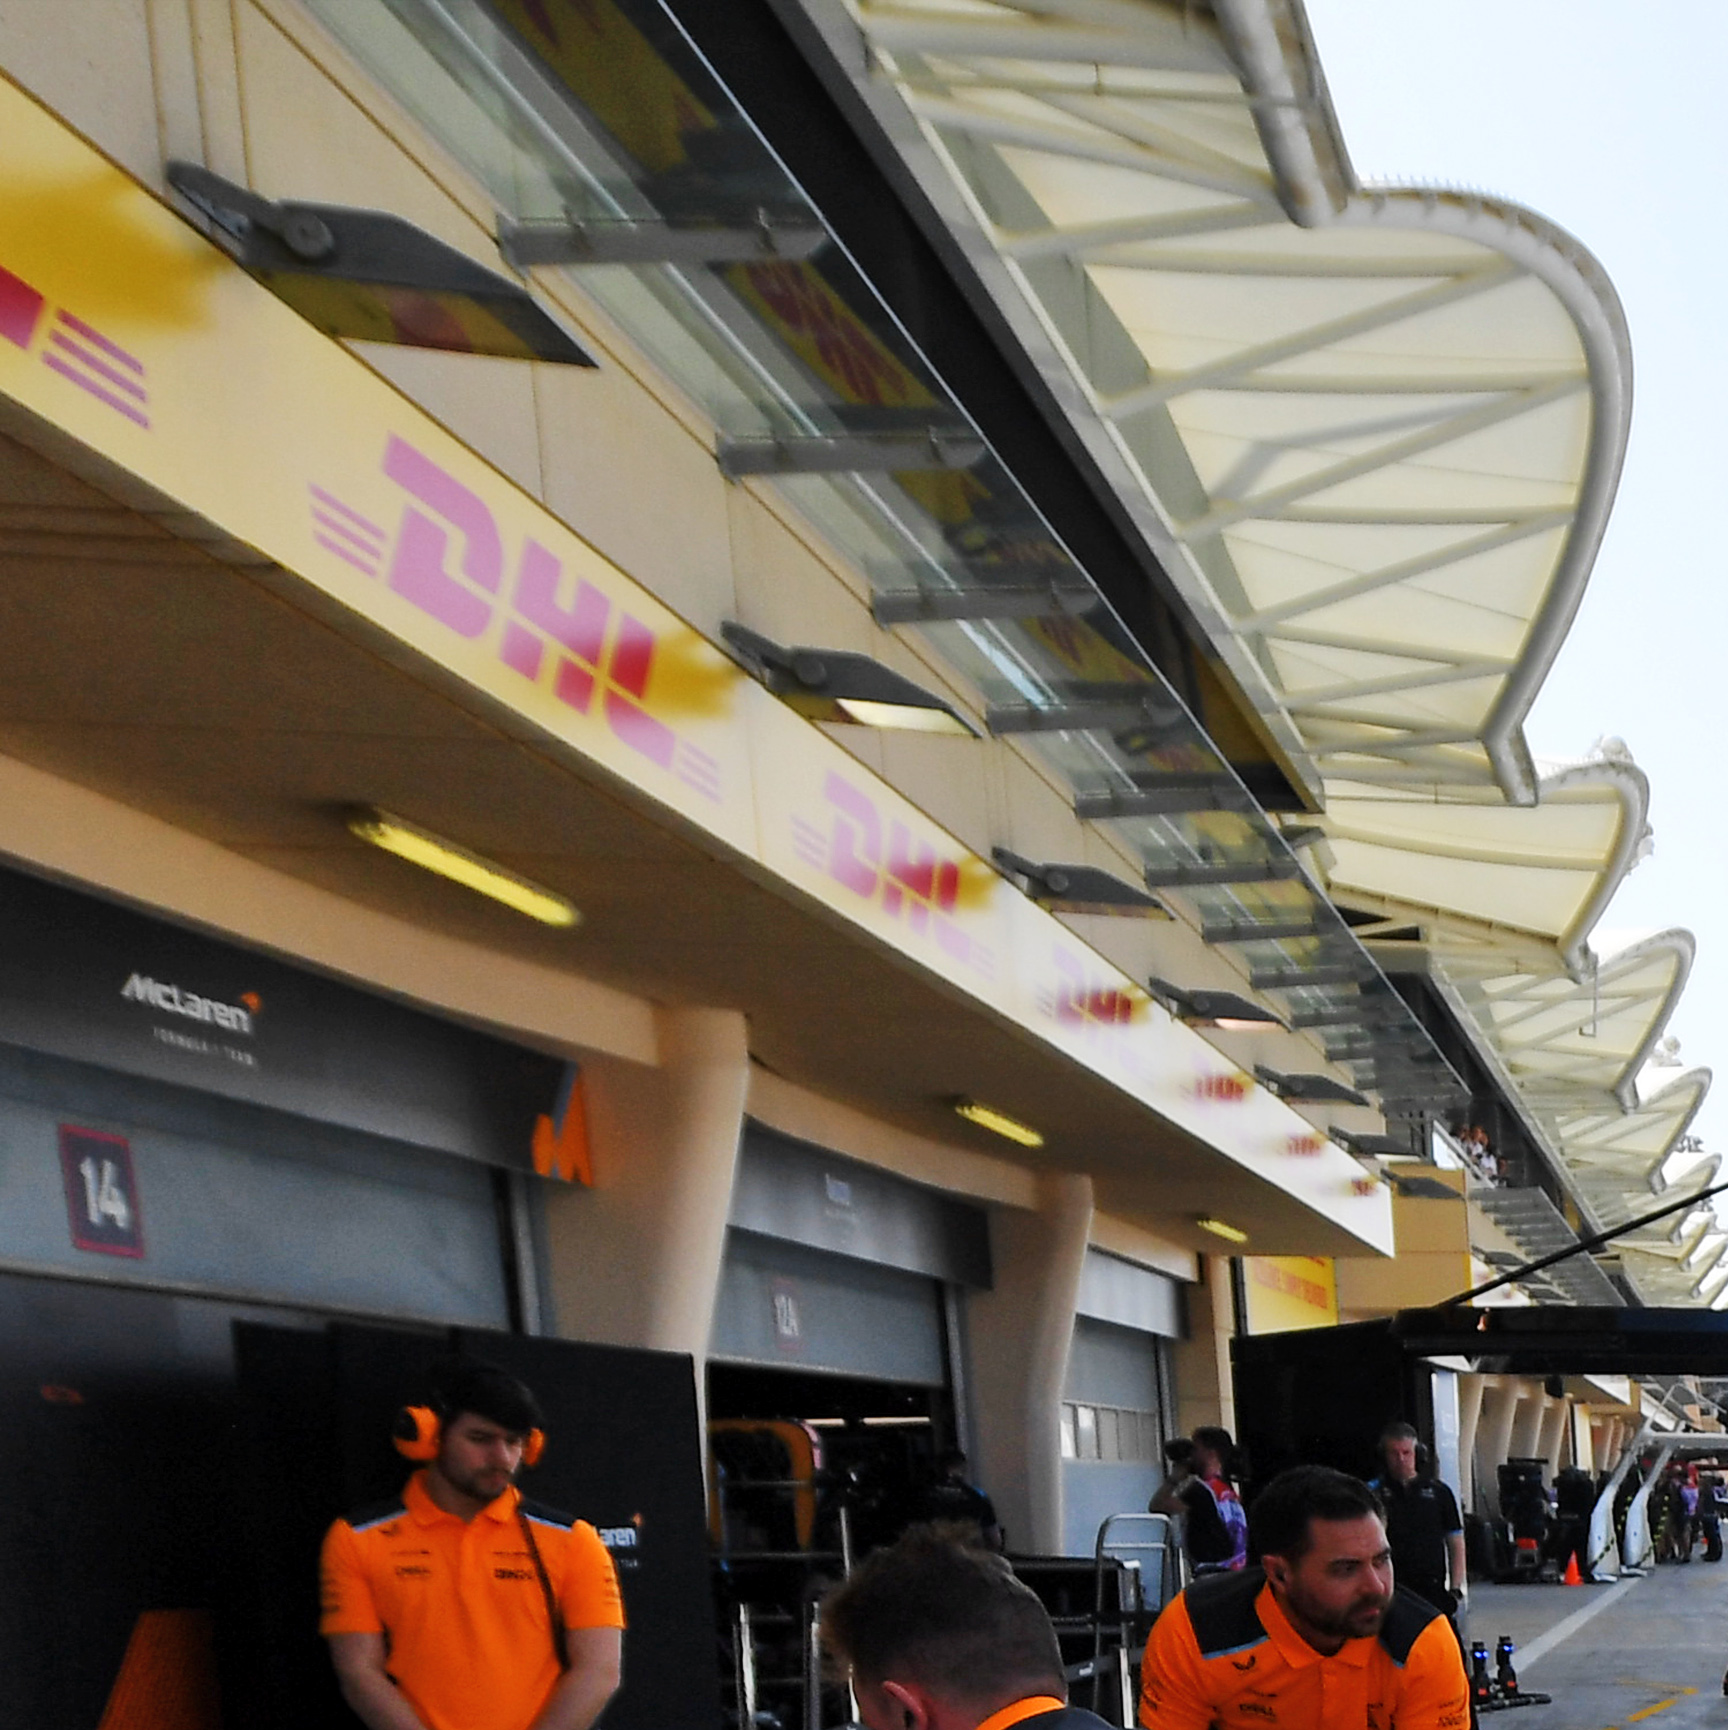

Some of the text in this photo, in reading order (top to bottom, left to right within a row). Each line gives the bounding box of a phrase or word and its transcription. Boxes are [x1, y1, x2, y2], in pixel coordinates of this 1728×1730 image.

[382, 432, 677, 768] DHL
[121, 973, 250, 1033] McLaren
[80, 1157, 127, 1228] 14
